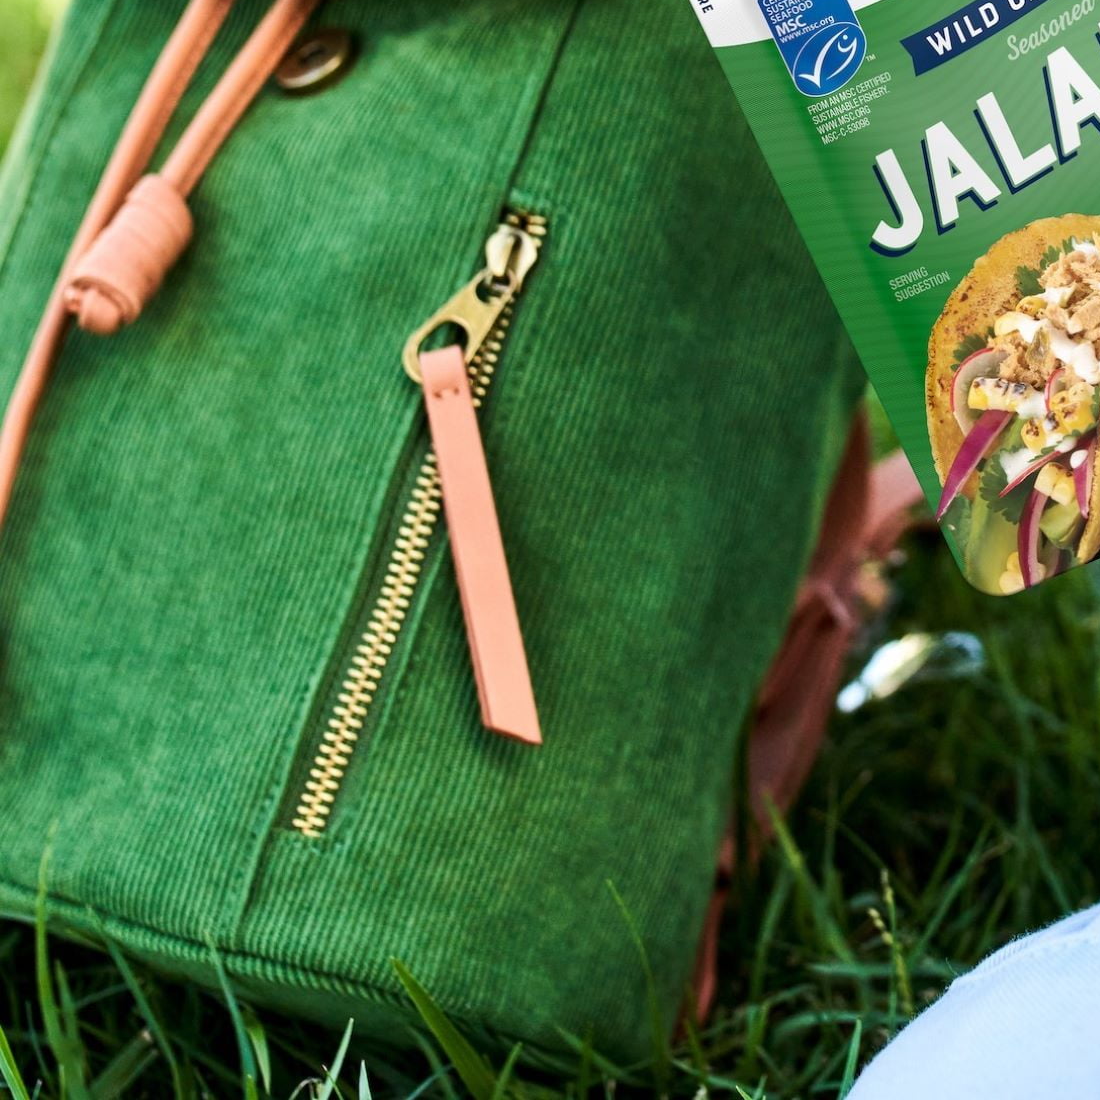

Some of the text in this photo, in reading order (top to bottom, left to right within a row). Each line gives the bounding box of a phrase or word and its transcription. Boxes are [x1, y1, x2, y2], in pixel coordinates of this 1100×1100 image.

[770, 0, 813, 24] SEAFOOD
[775, 15, 807, 37] MSC
[780, 15, 835, 44] www.msc.org
[926, 2, 1001, 57] WILD
[807, 72, 892, 115] FROM AN MSC CERTIFIED
[812, 85, 891, 125] SUSTAINABLE FISHERY.
[816, 105, 871, 135] WWW.MSC.ORG
[821, 118, 870, 145] MSC-C-53098
[889, 266, 929, 290] SERVING
[894, 271, 951, 302] SUGGESTION
